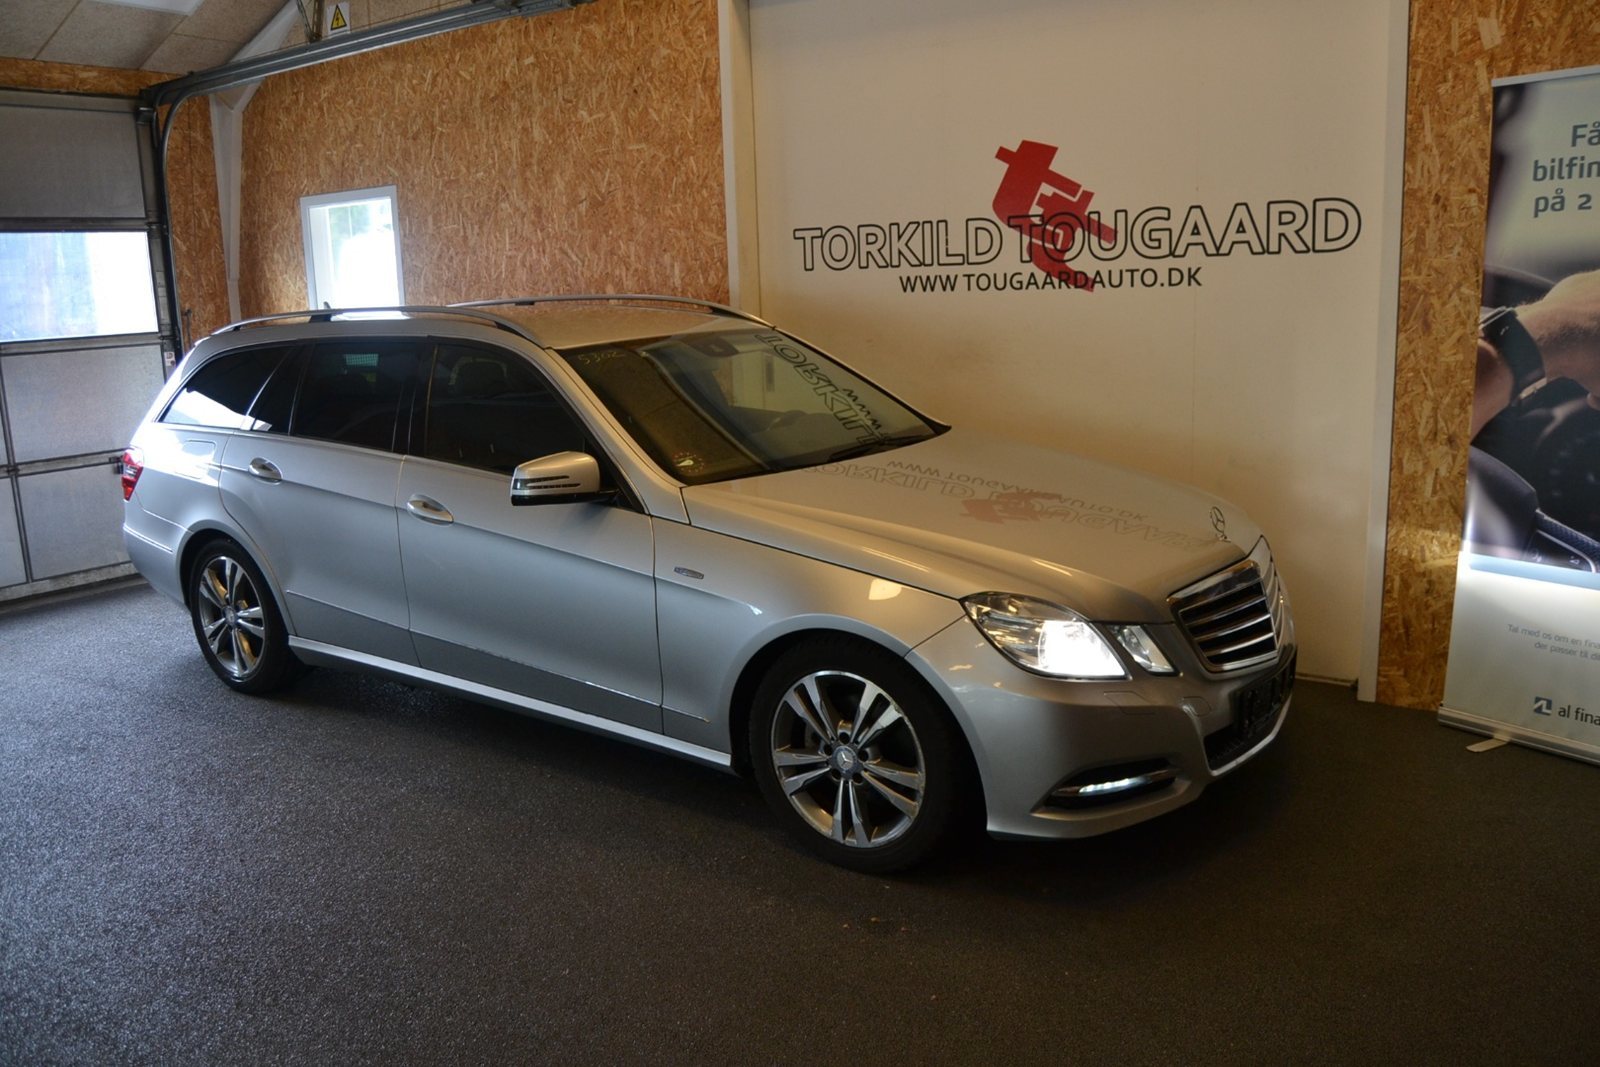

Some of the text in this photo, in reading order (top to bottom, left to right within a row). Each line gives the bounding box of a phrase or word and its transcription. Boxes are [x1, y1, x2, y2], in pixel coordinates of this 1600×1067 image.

[1570, 121, 1600, 147] Få
[1532, 155, 1600, 182] bilfin
[1533, 188, 1593, 218] på 2
[793, 196, 1362, 272] TORKILD TOUGAARD
[1558, 704, 1571, 719] al
